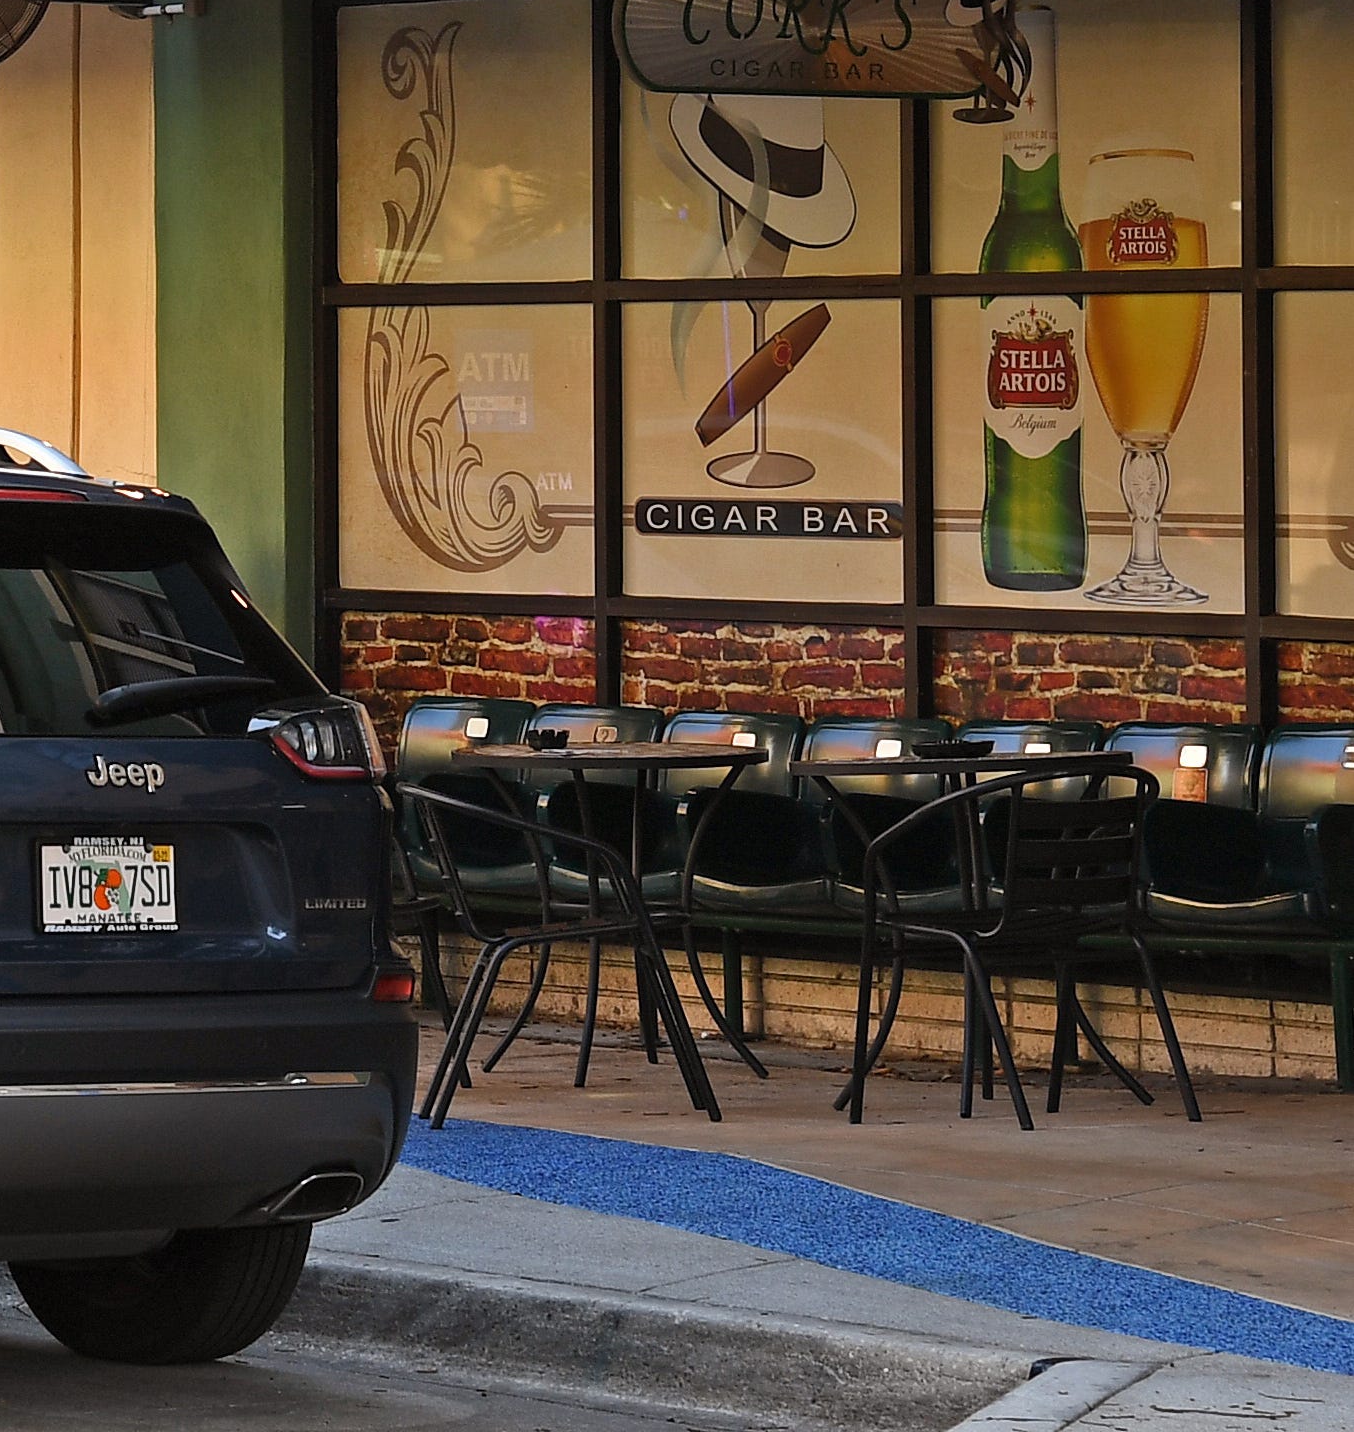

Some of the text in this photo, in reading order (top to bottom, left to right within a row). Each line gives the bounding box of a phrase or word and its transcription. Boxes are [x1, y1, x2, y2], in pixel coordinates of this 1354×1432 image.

[709, 58, 885, 82] CIGAR BAR
[1118, 226, 1167, 240] STELLA
[1118, 240, 1168, 255] ARTOIS
[458, 351, 532, 383] ATM
[998, 349, 1067, 370] STELLA
[998, 371, 1067, 393] ARTOIS
[1007, 412, 1058, 438] Belgium
[535, 471, 574, 492] ATM
[644, 502, 892, 536] CIGAR BAR
[85, 754, 166, 794] Jeep
[129, 836, 144, 847] NJ
[304, 898, 367, 909] LIMITED
[44, 923, 179, 933] RAMSEY Auto Group
[77, 912, 142, 924] MANATEE
